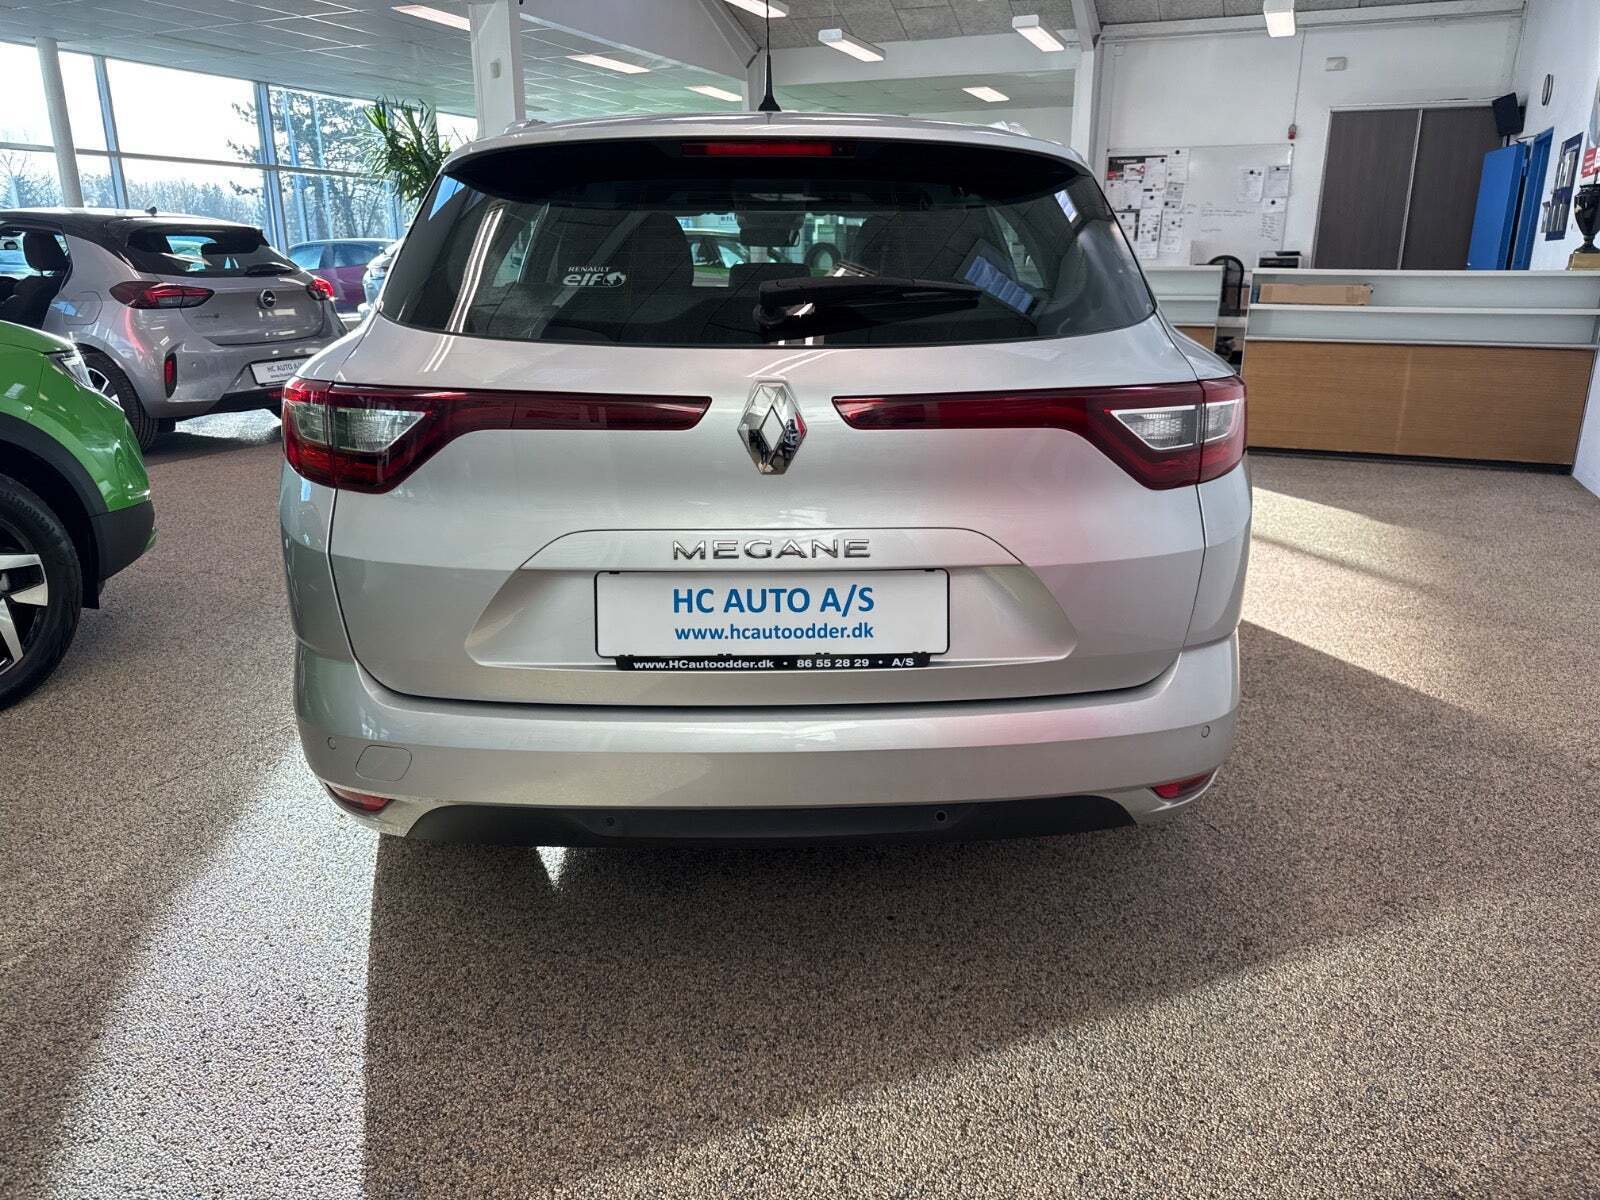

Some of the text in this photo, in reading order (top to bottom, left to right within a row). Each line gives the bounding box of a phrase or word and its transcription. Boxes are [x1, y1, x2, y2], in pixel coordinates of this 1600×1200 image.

[562, 273, 603, 286] elf
[672, 539, 871, 560] MEGANE
[673, 584, 875, 617] HC AUTO A/S
[675, 622, 875, 640] www.hcautoodder.dk
[633, 657, 915, 669] www.HCautoodder.dk 86 55 28 29 A/S
